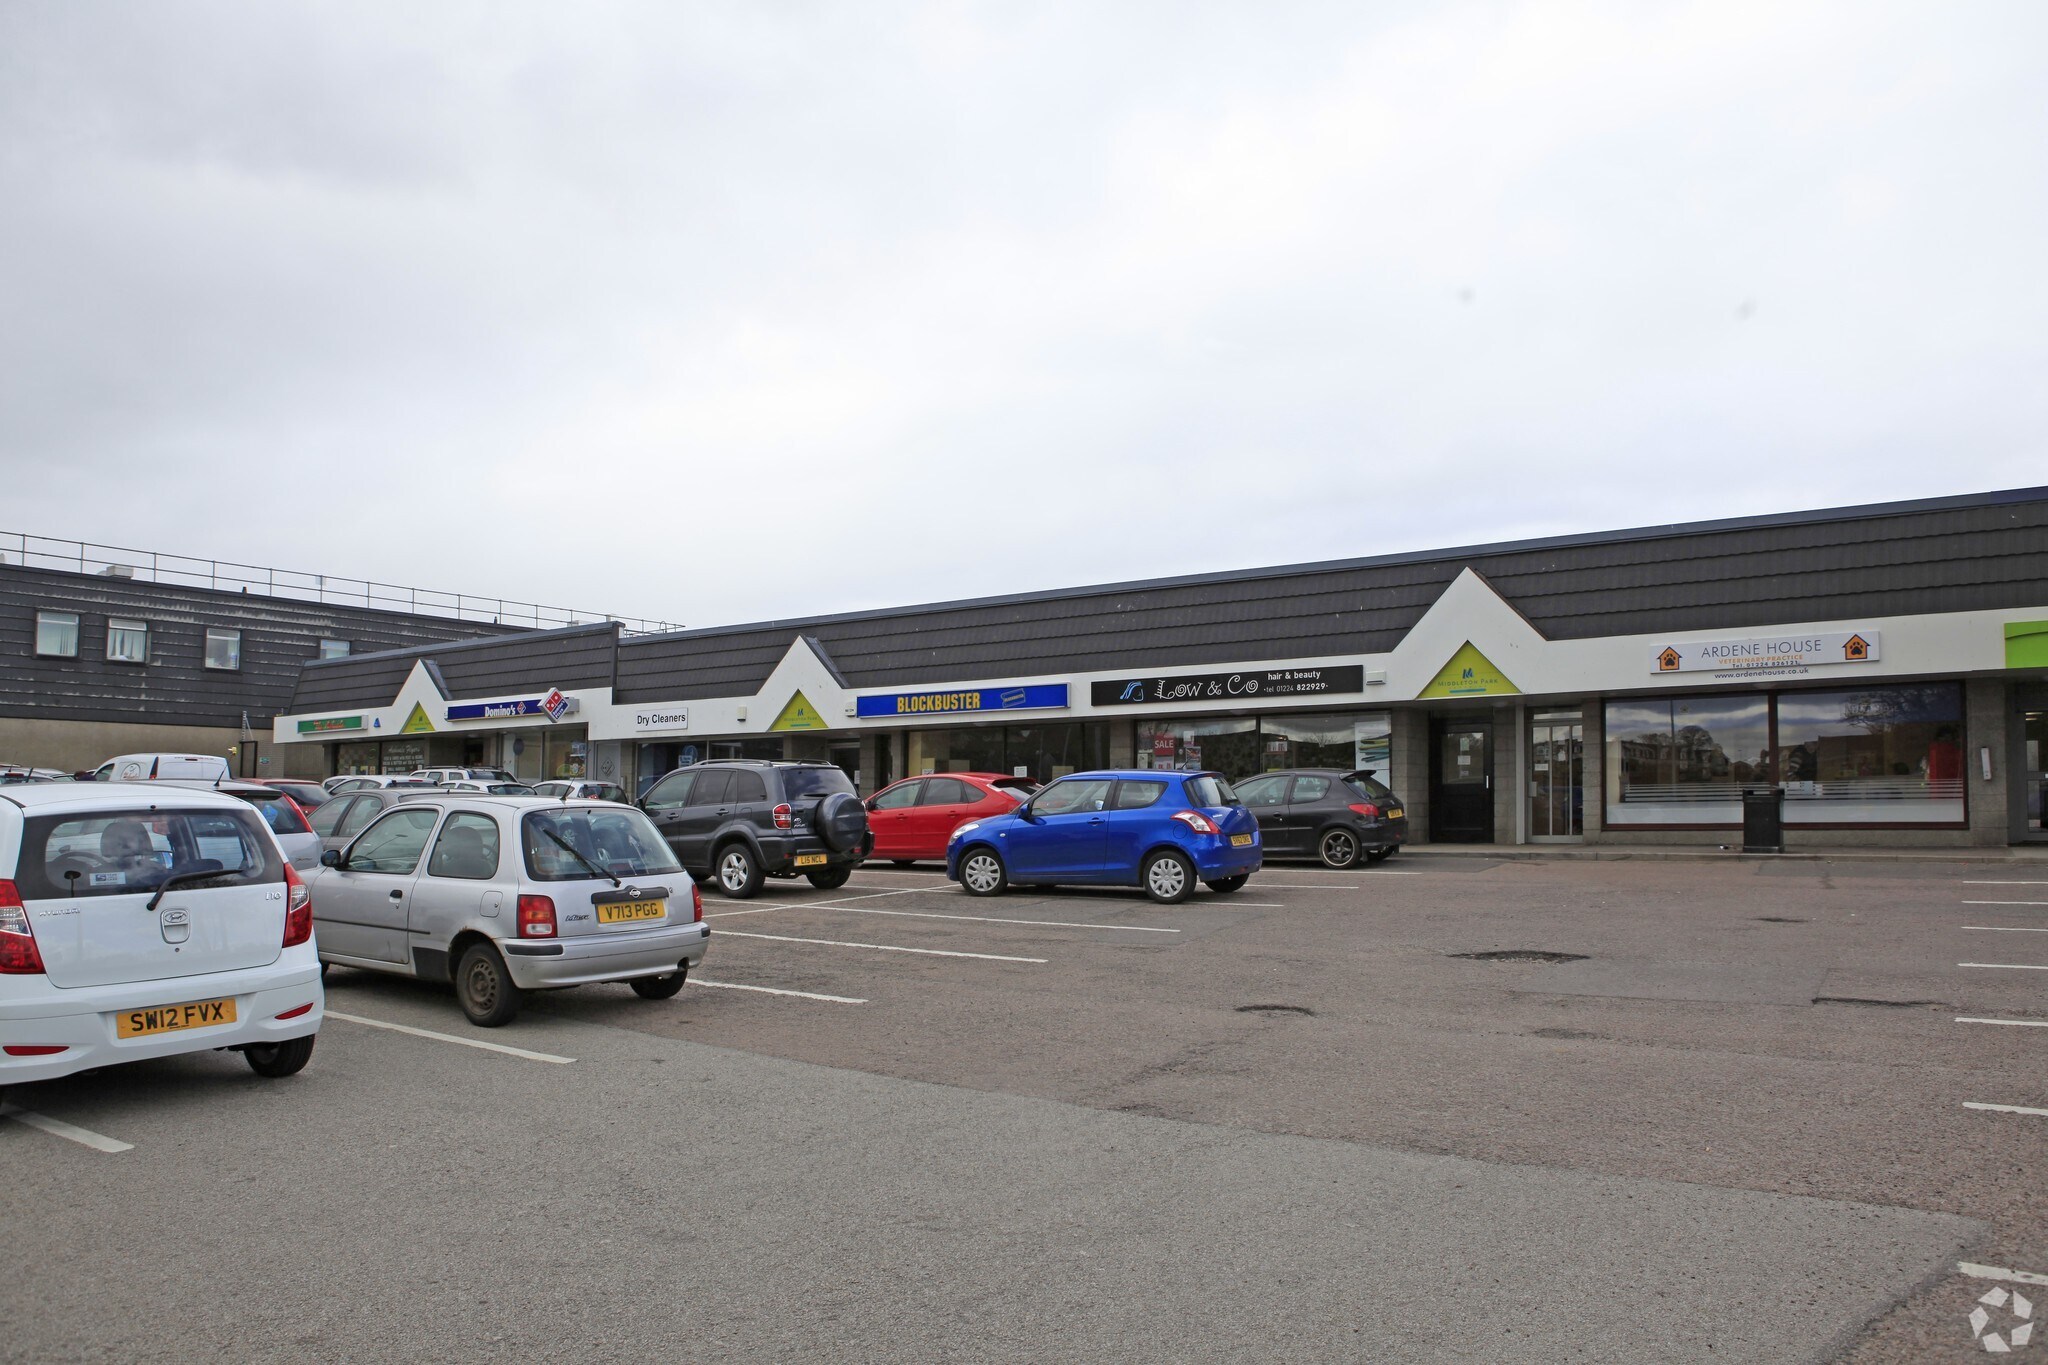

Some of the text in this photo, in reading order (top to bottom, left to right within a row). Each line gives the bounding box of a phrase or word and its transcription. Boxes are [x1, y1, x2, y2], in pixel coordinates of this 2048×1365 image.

[1701, 640, 1822, 658] ARDENE HOUSE
[1718, 654, 1804, 665] VETERINARY PRACTICE
[1268, 670, 1321, 681] hair & beauty
[1714, 667, 1809, 679] www.ardenehouse.co.uk
[1206, 681, 1222, 696] &
[1438, 679, 1478, 687] MIDDLETON
[896, 692, 980, 713] BLOCKBUSTER
[485, 704, 516, 717] Domino's
[637, 713, 686, 726] Dry Cleaners
[1154, 739, 1174, 749] SALE
[39, 907, 81, 917] HYUNDAI
[605, 902, 658, 920] V713 PGG
[130, 1002, 224, 1032] SW12 FVX
